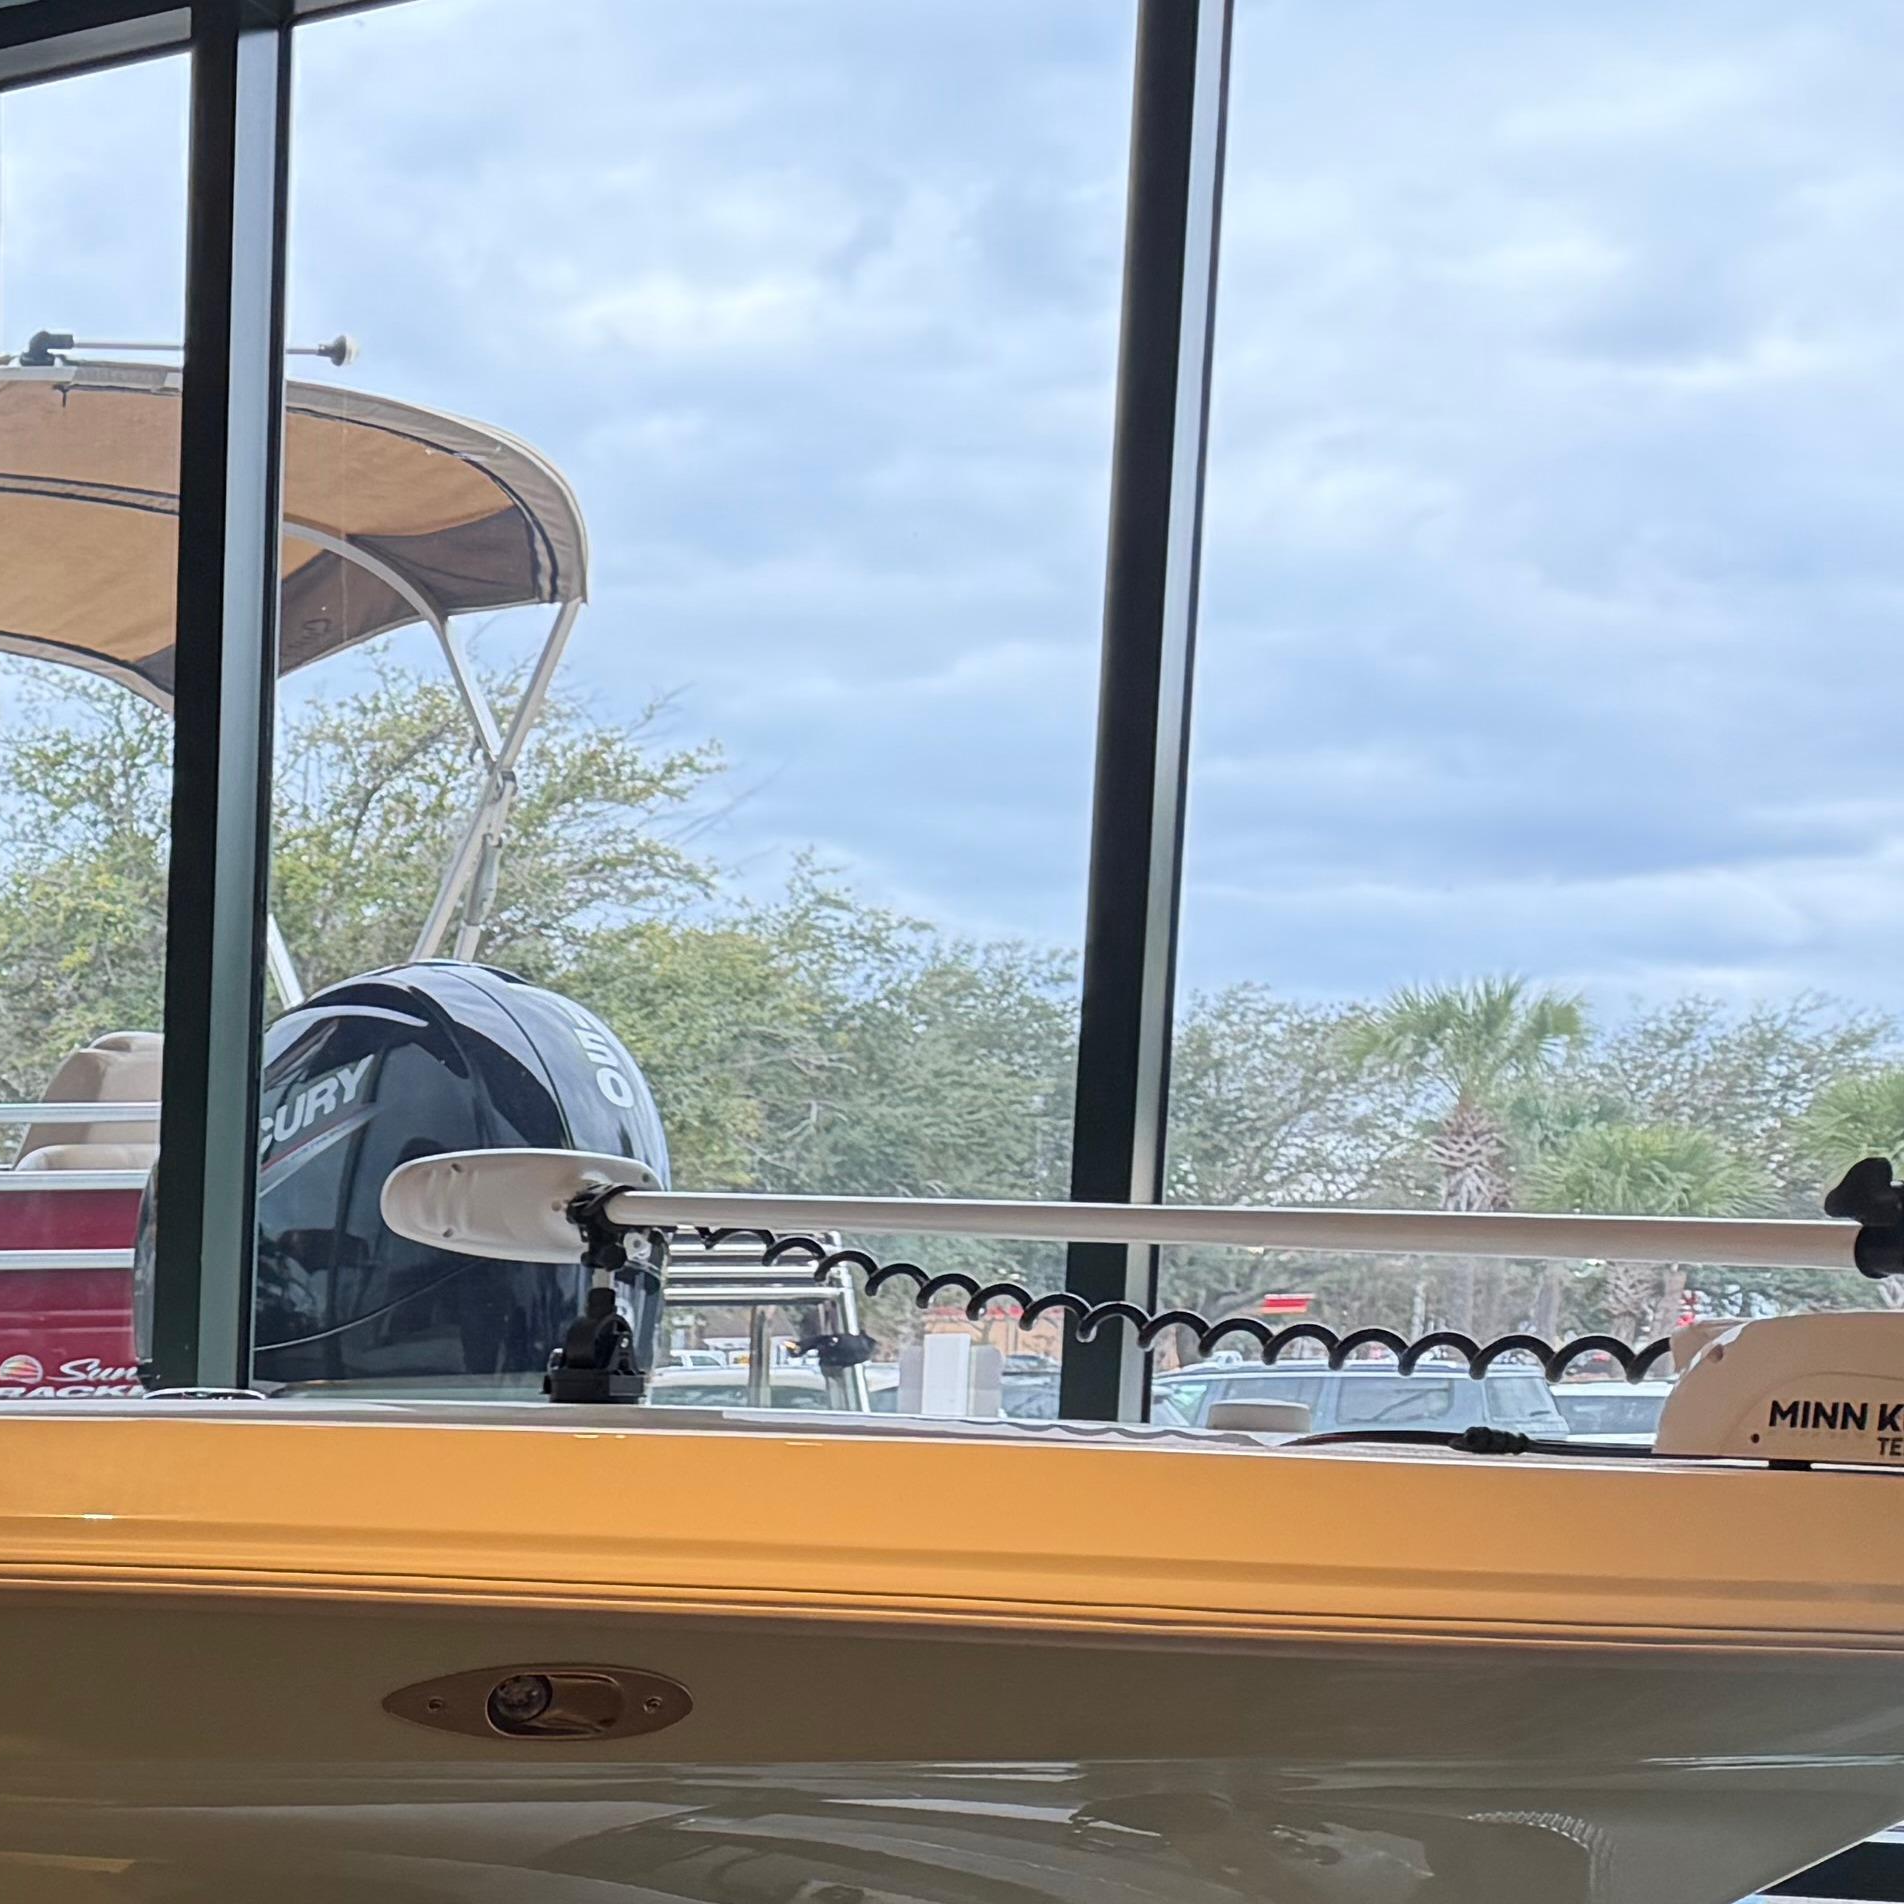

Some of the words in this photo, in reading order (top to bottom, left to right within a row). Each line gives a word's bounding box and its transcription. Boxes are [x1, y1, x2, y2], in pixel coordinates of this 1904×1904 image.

[46, 1358, 138, 1383] Sun
[1769, 1400, 1868, 1431] MINN
[1877, 1403, 1904, 1432] K
[1877, 1437, 1904, 1457] TE
